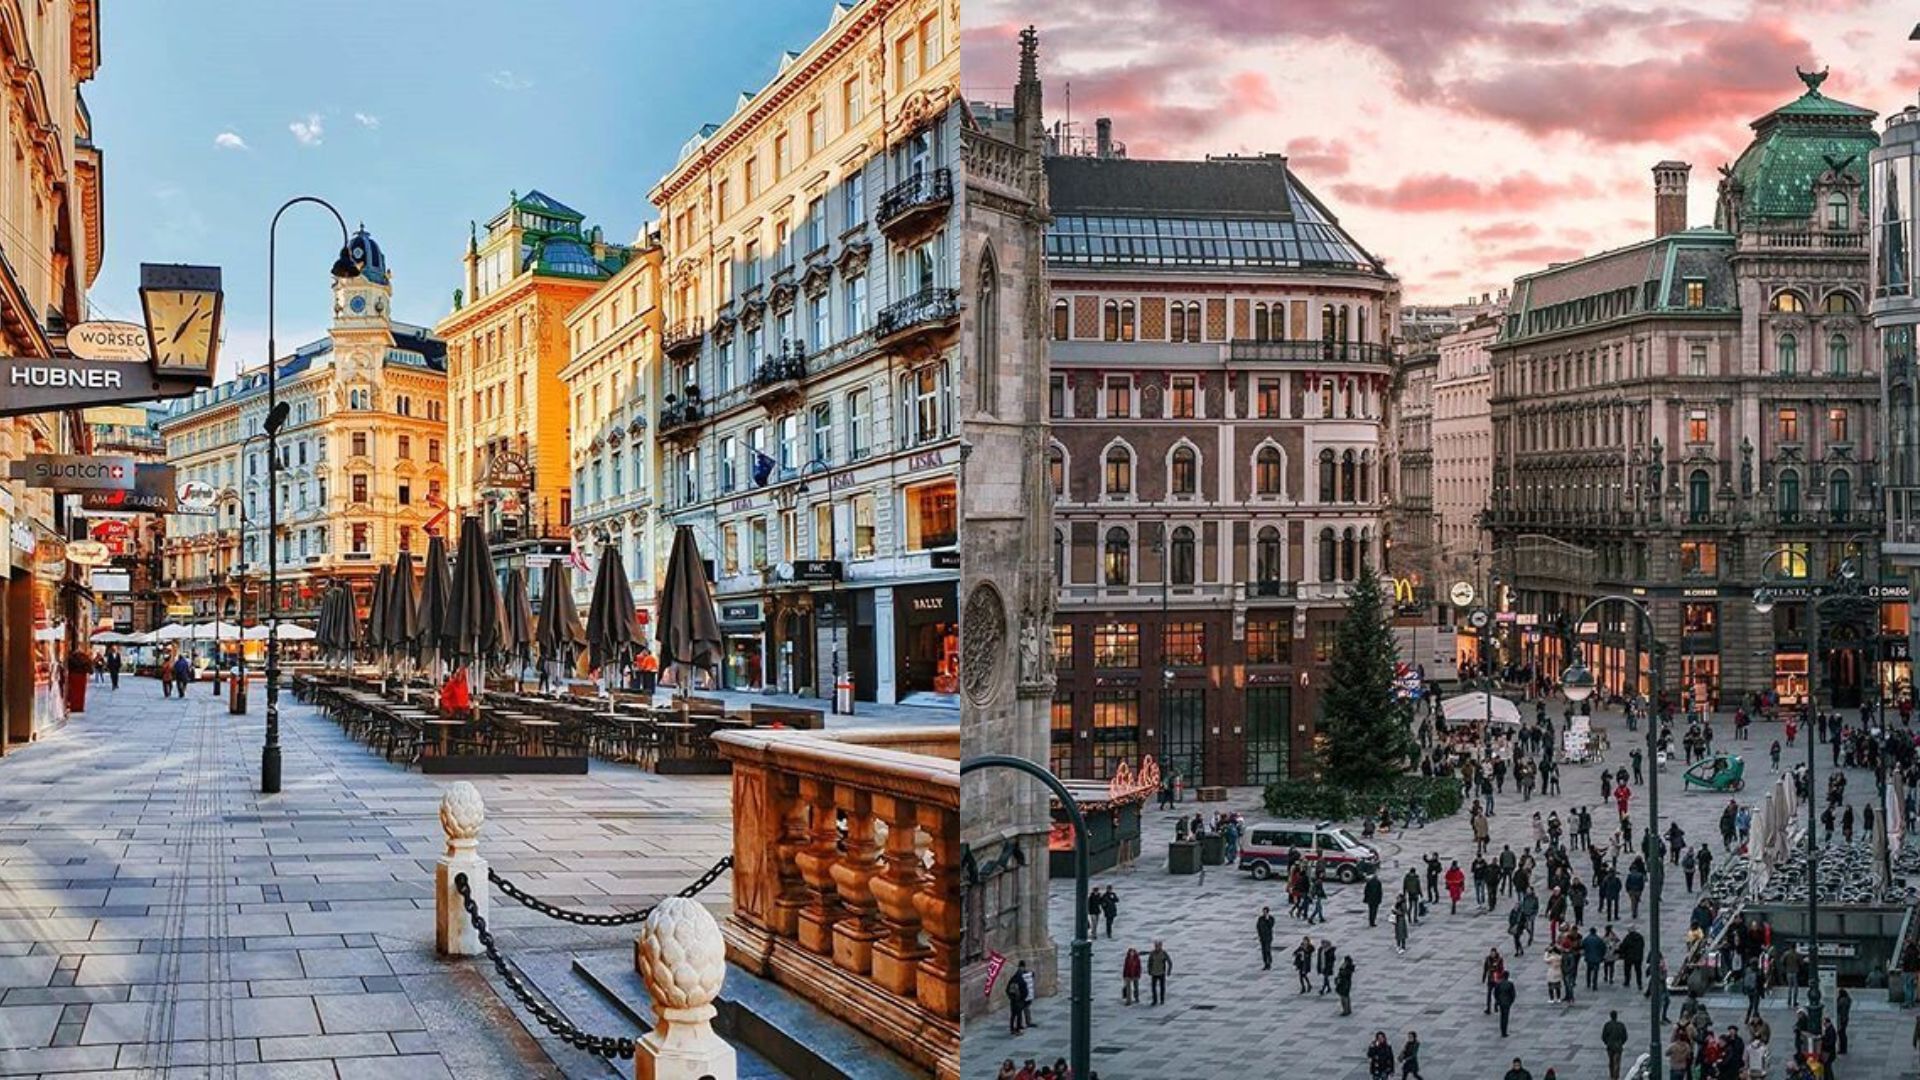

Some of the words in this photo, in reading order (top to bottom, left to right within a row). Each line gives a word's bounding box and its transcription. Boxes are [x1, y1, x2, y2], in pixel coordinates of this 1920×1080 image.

[80, 331, 146, 347] WORSEG
[11, 366, 122, 388] HÜBNER
[908, 450, 944, 471] LISKA
[35, 462, 110, 478] swatch
[89, 494, 109, 504] AM
[124, 493, 169, 507] GRABEN
[912, 598, 944, 610] BALLY
